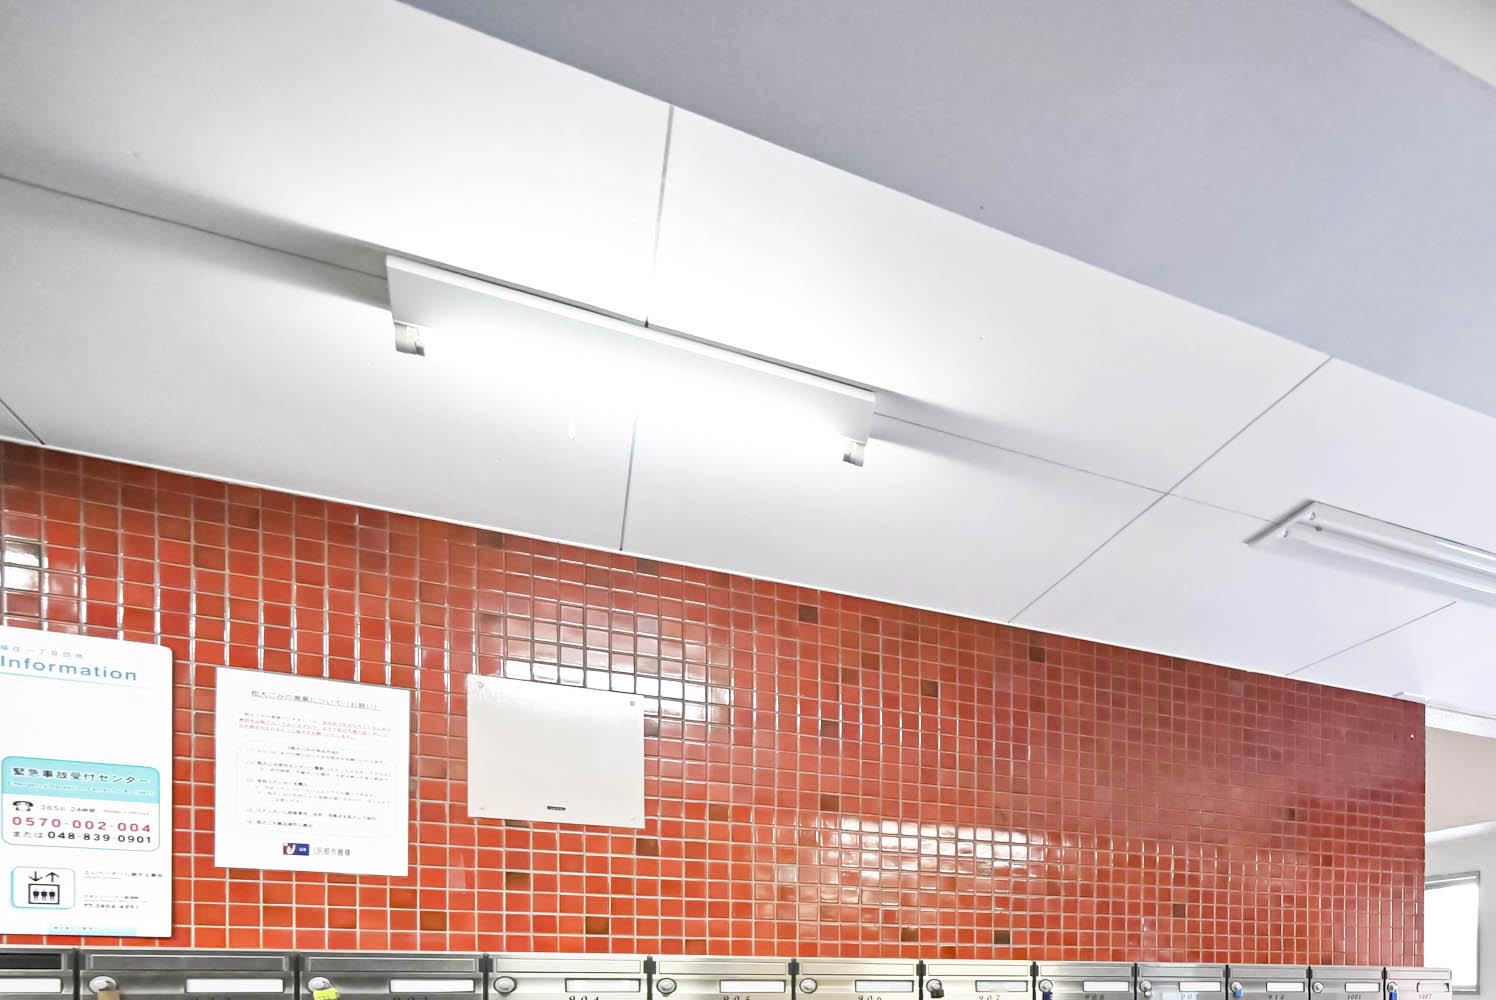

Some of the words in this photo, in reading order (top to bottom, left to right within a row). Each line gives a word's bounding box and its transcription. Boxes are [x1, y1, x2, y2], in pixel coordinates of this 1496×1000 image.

[0, 655, 137, 680] Information
[12, 767, 150, 784] 緊急事故受付センター
[12, 816, 151, 833] 0570-002-004
[47, 831, 151, 844] 048-839-0901
